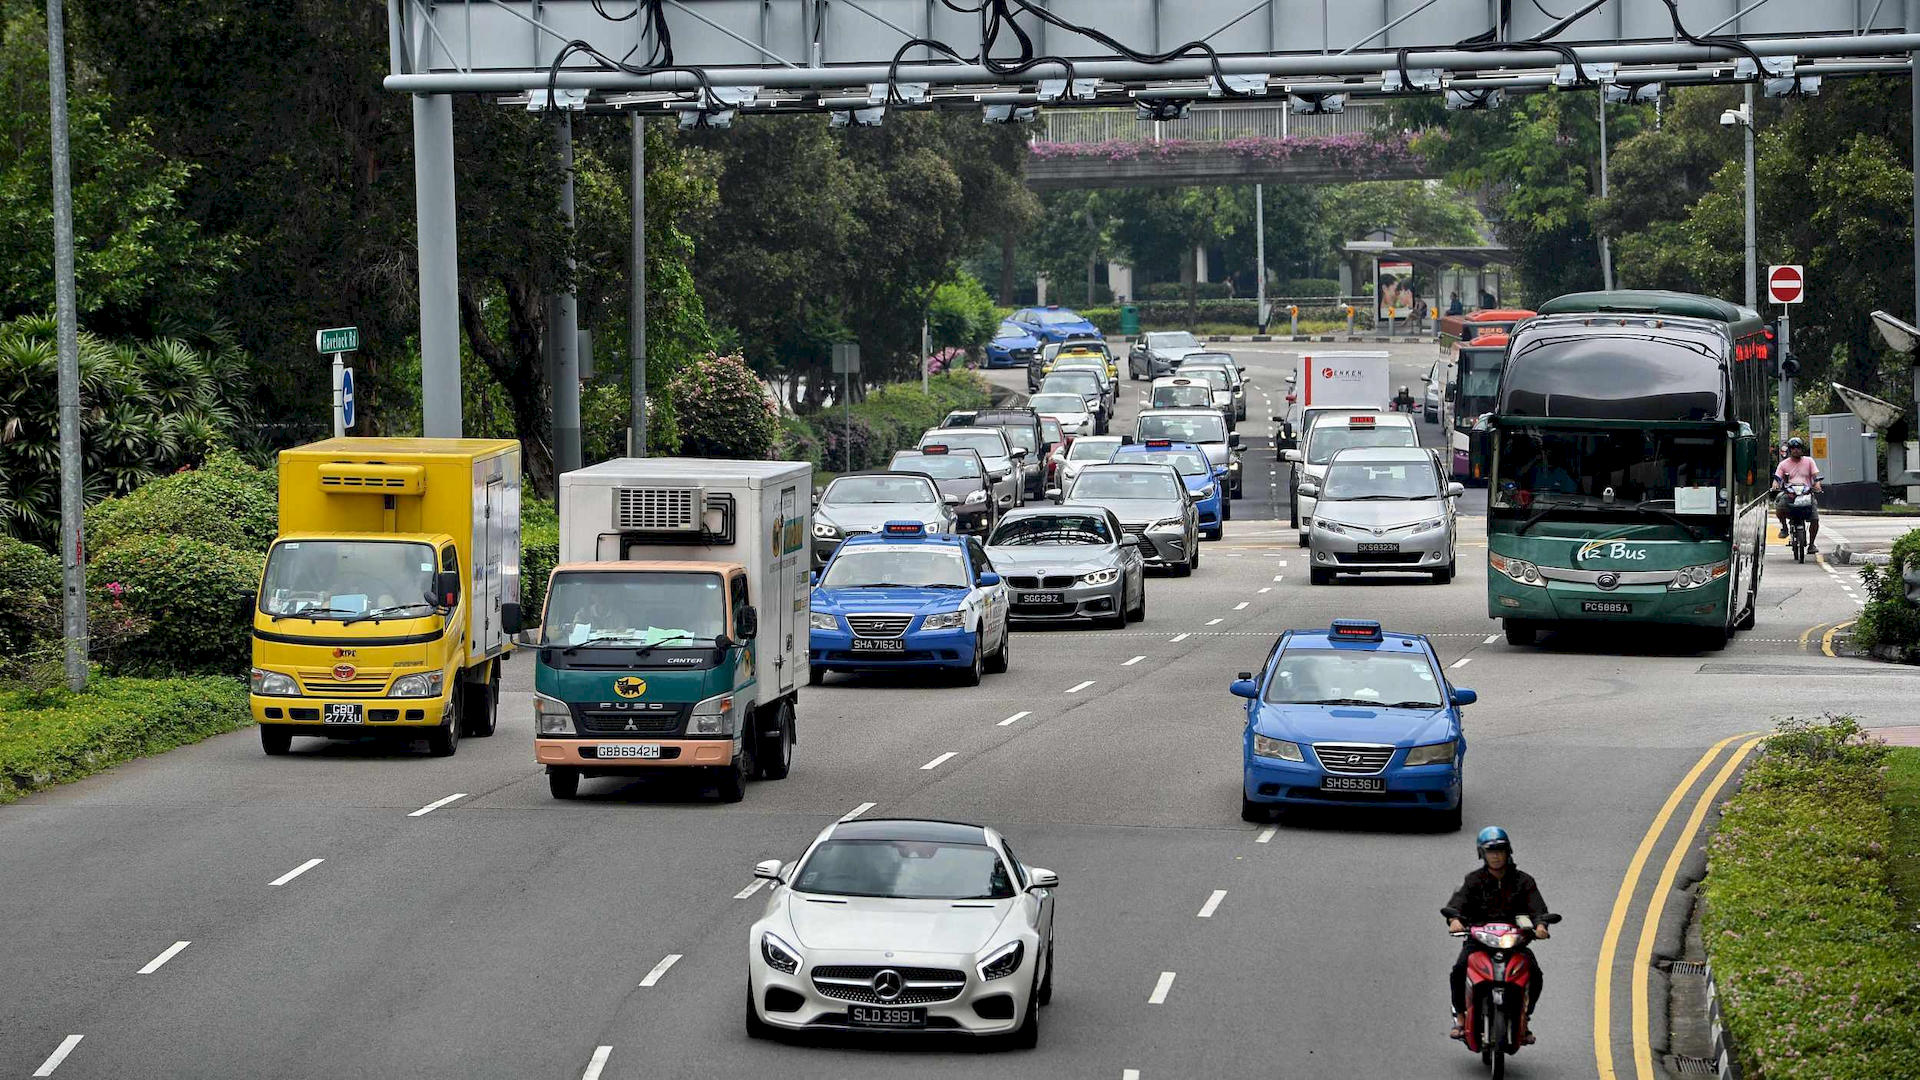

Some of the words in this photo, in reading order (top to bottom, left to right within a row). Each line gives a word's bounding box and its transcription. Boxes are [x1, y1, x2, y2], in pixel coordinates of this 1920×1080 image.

[323, 333, 348, 350] Havelock
[349, 331, 356, 347] Rd
[1609, 542, 1647, 560] Bus
[332, 704, 354, 715] GBD
[325, 713, 362, 723] 2773U
